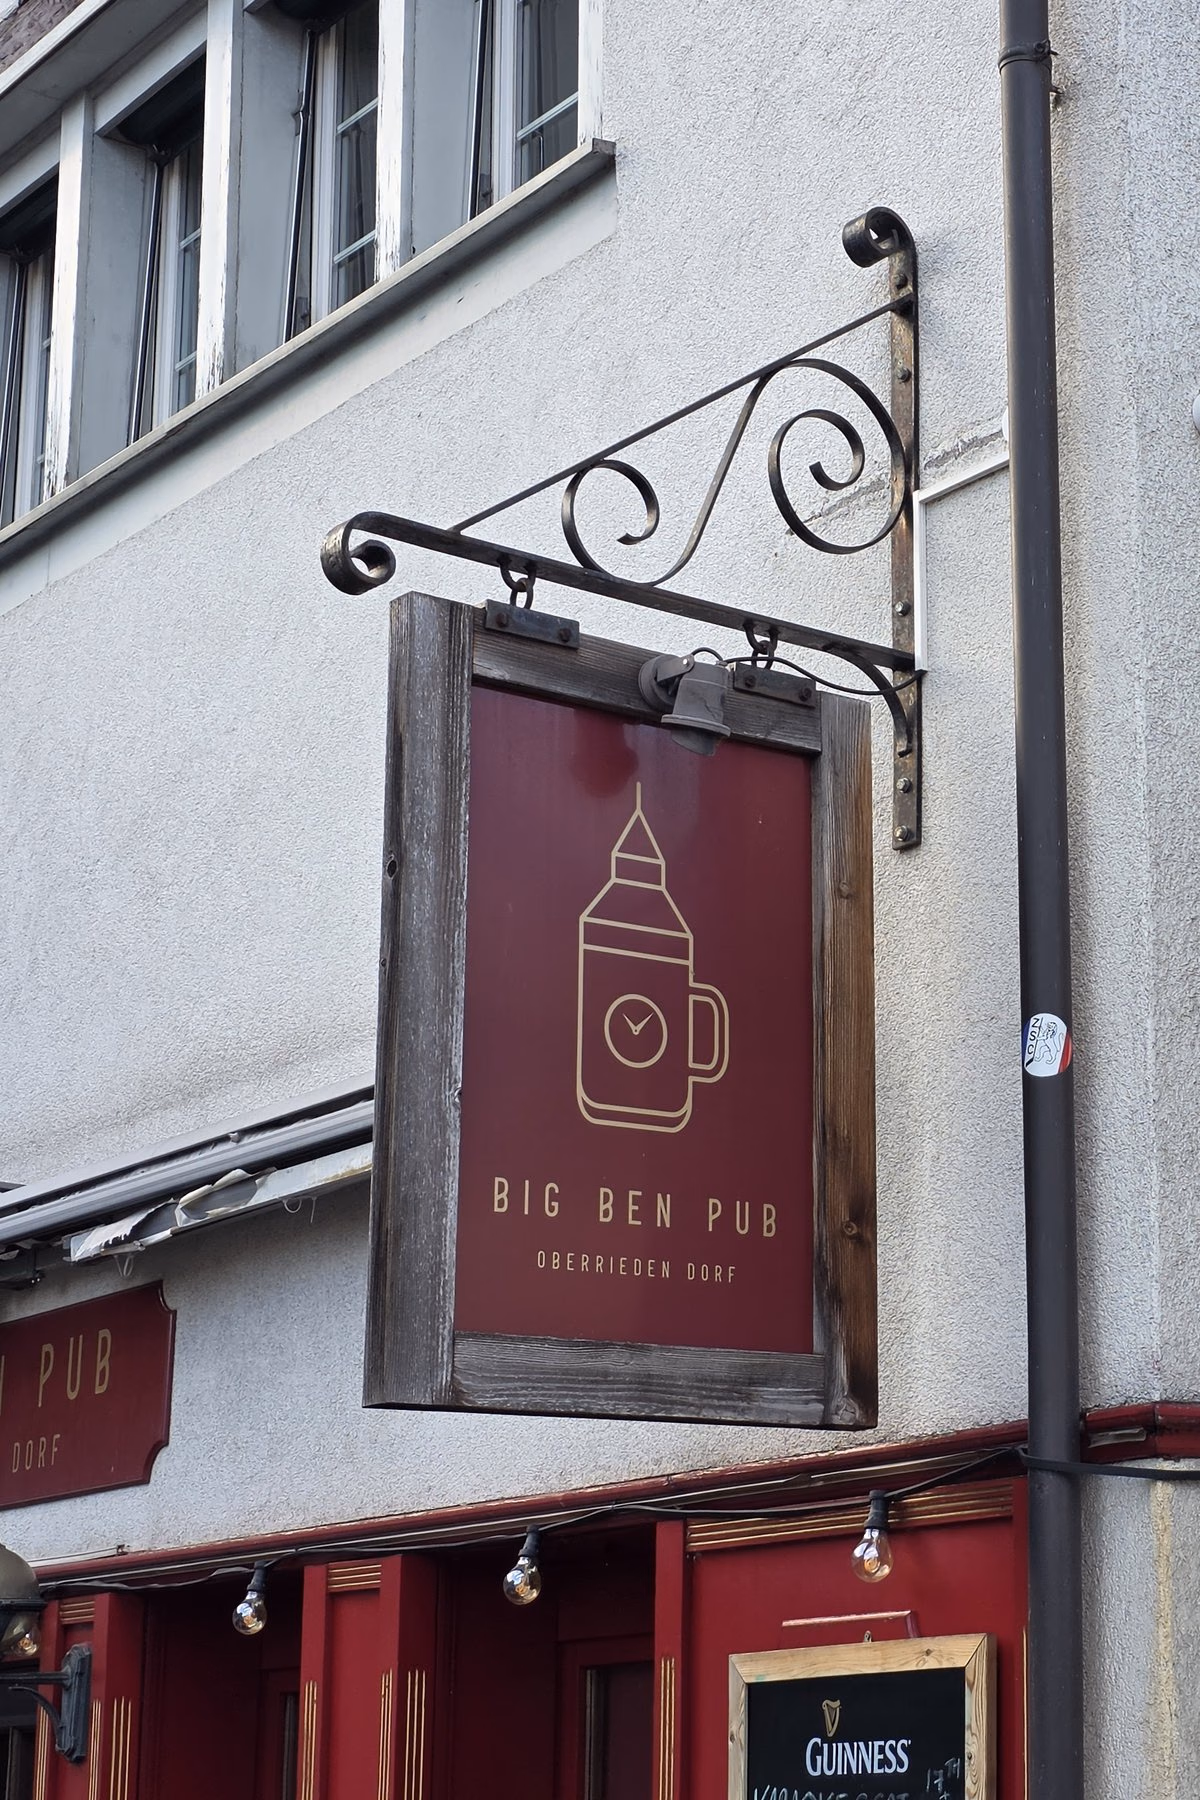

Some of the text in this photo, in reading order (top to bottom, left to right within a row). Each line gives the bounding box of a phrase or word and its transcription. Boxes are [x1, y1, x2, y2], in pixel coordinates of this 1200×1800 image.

[1027, 1017, 1040, 1055] ZSC
[493, 1176, 777, 1238] BIG BEN PUB
[537, 1250, 736, 1283] OBERRIEDEN DORF
[38, 1328, 112, 1408] PUB
[12, 1433, 61, 1473] DORF
